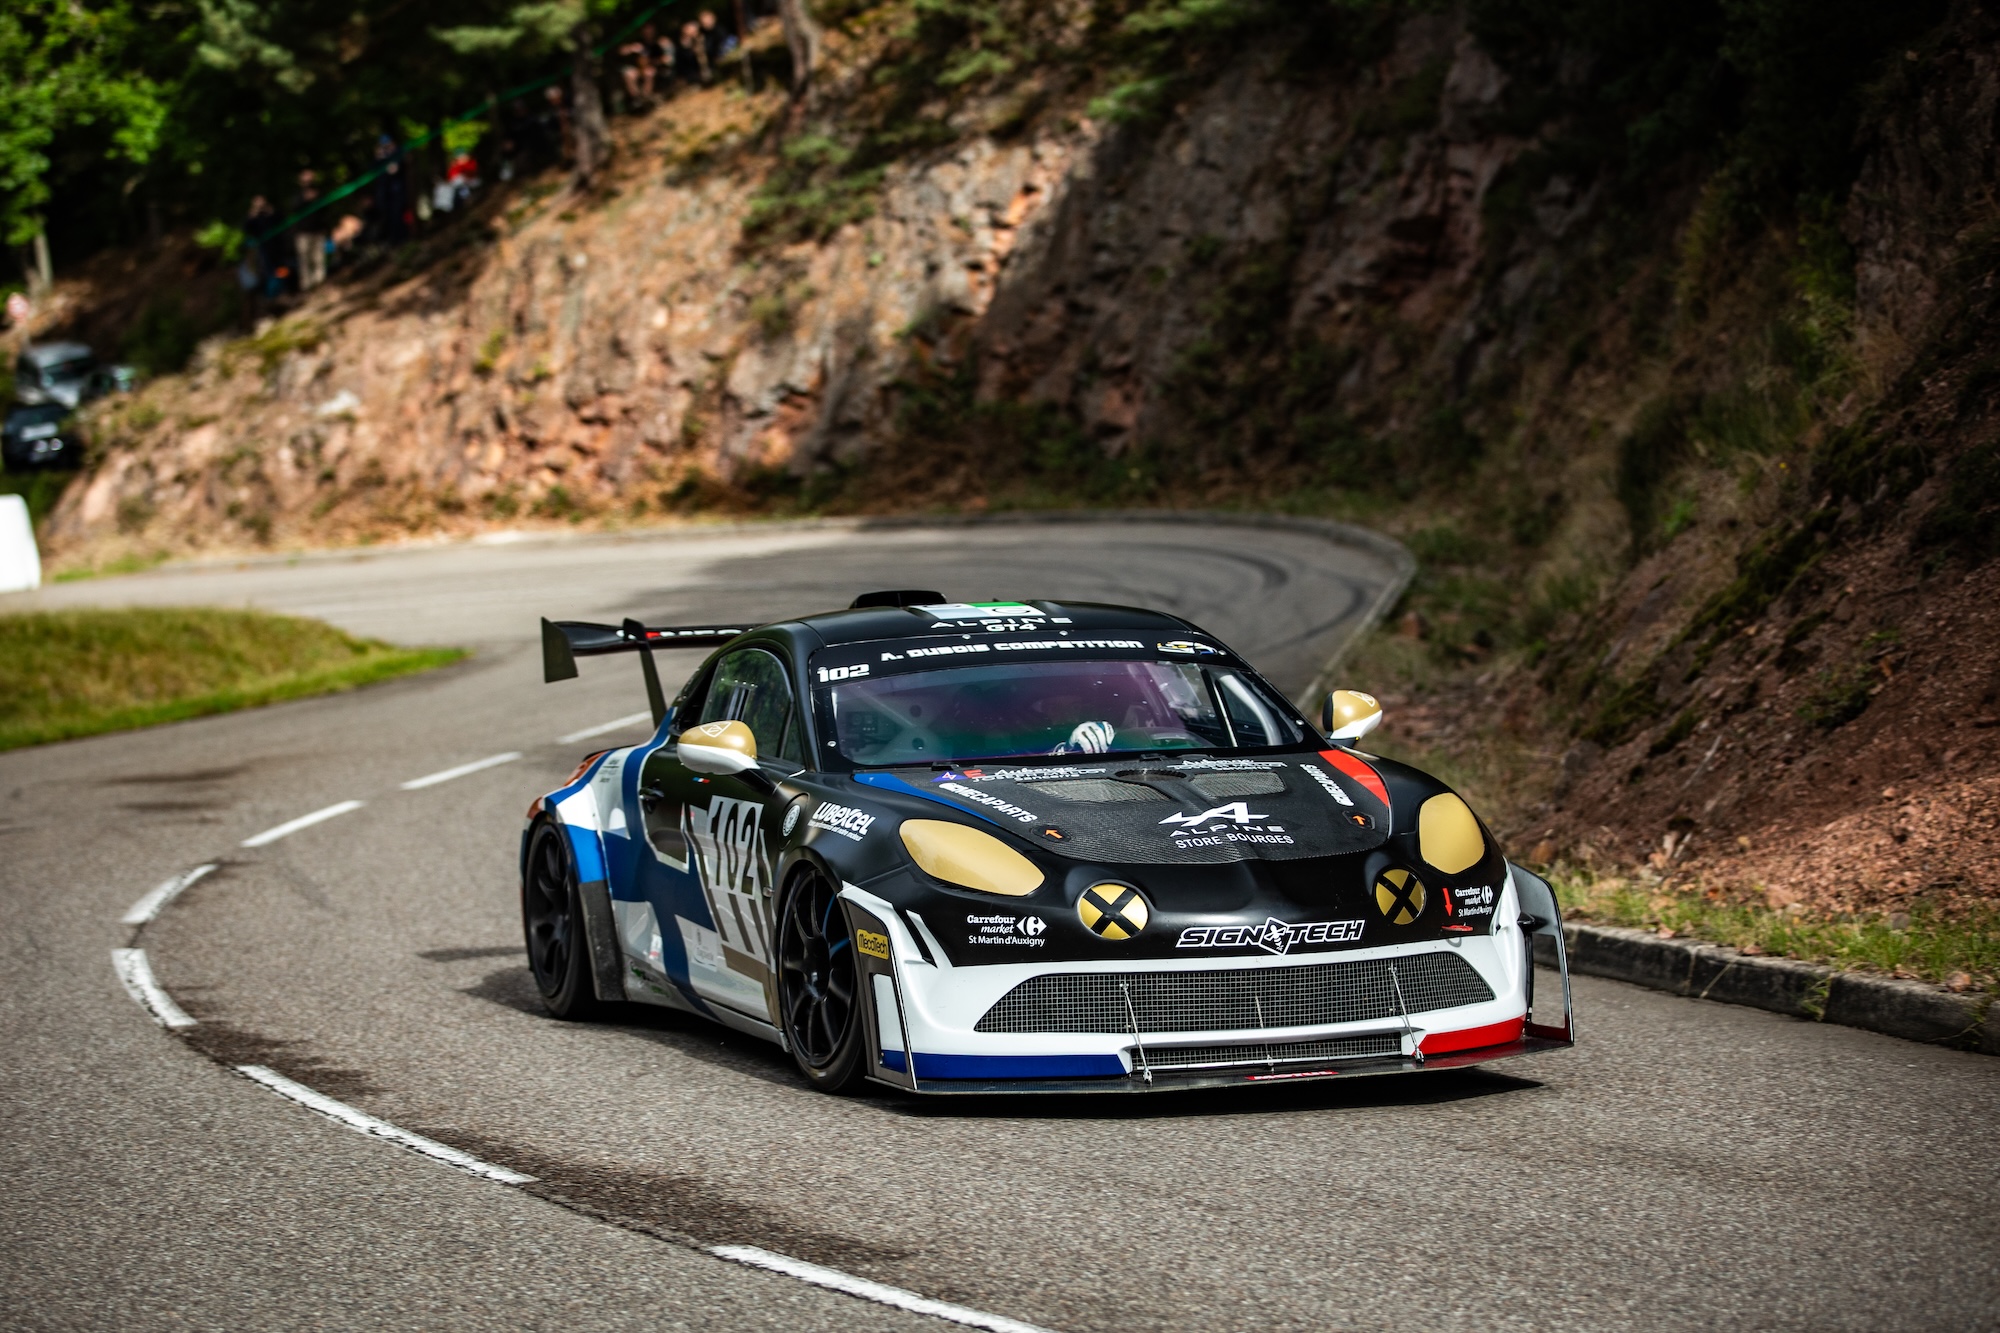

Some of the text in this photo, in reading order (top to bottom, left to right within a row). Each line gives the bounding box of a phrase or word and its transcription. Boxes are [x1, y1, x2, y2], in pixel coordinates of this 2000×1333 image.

[930, 617, 1073, 629] ALPINE
[985, 623, 1037, 632] GT4
[881, 652, 905, 662] A.
[906, 644, 991, 658] DUBOIS
[993, 640, 1145, 652] COMPETITION
[816, 664, 870, 683] 102
[1169, 824, 1286, 837] ALPINE
[1175, 832, 1295, 849] STORE BOURGES
[710, 801, 756, 896] 102
[966, 915, 1016, 924] Carrefour
[980, 925, 1015, 934] market
[968, 935, 1046, 947] St Martin d'Auxigny
